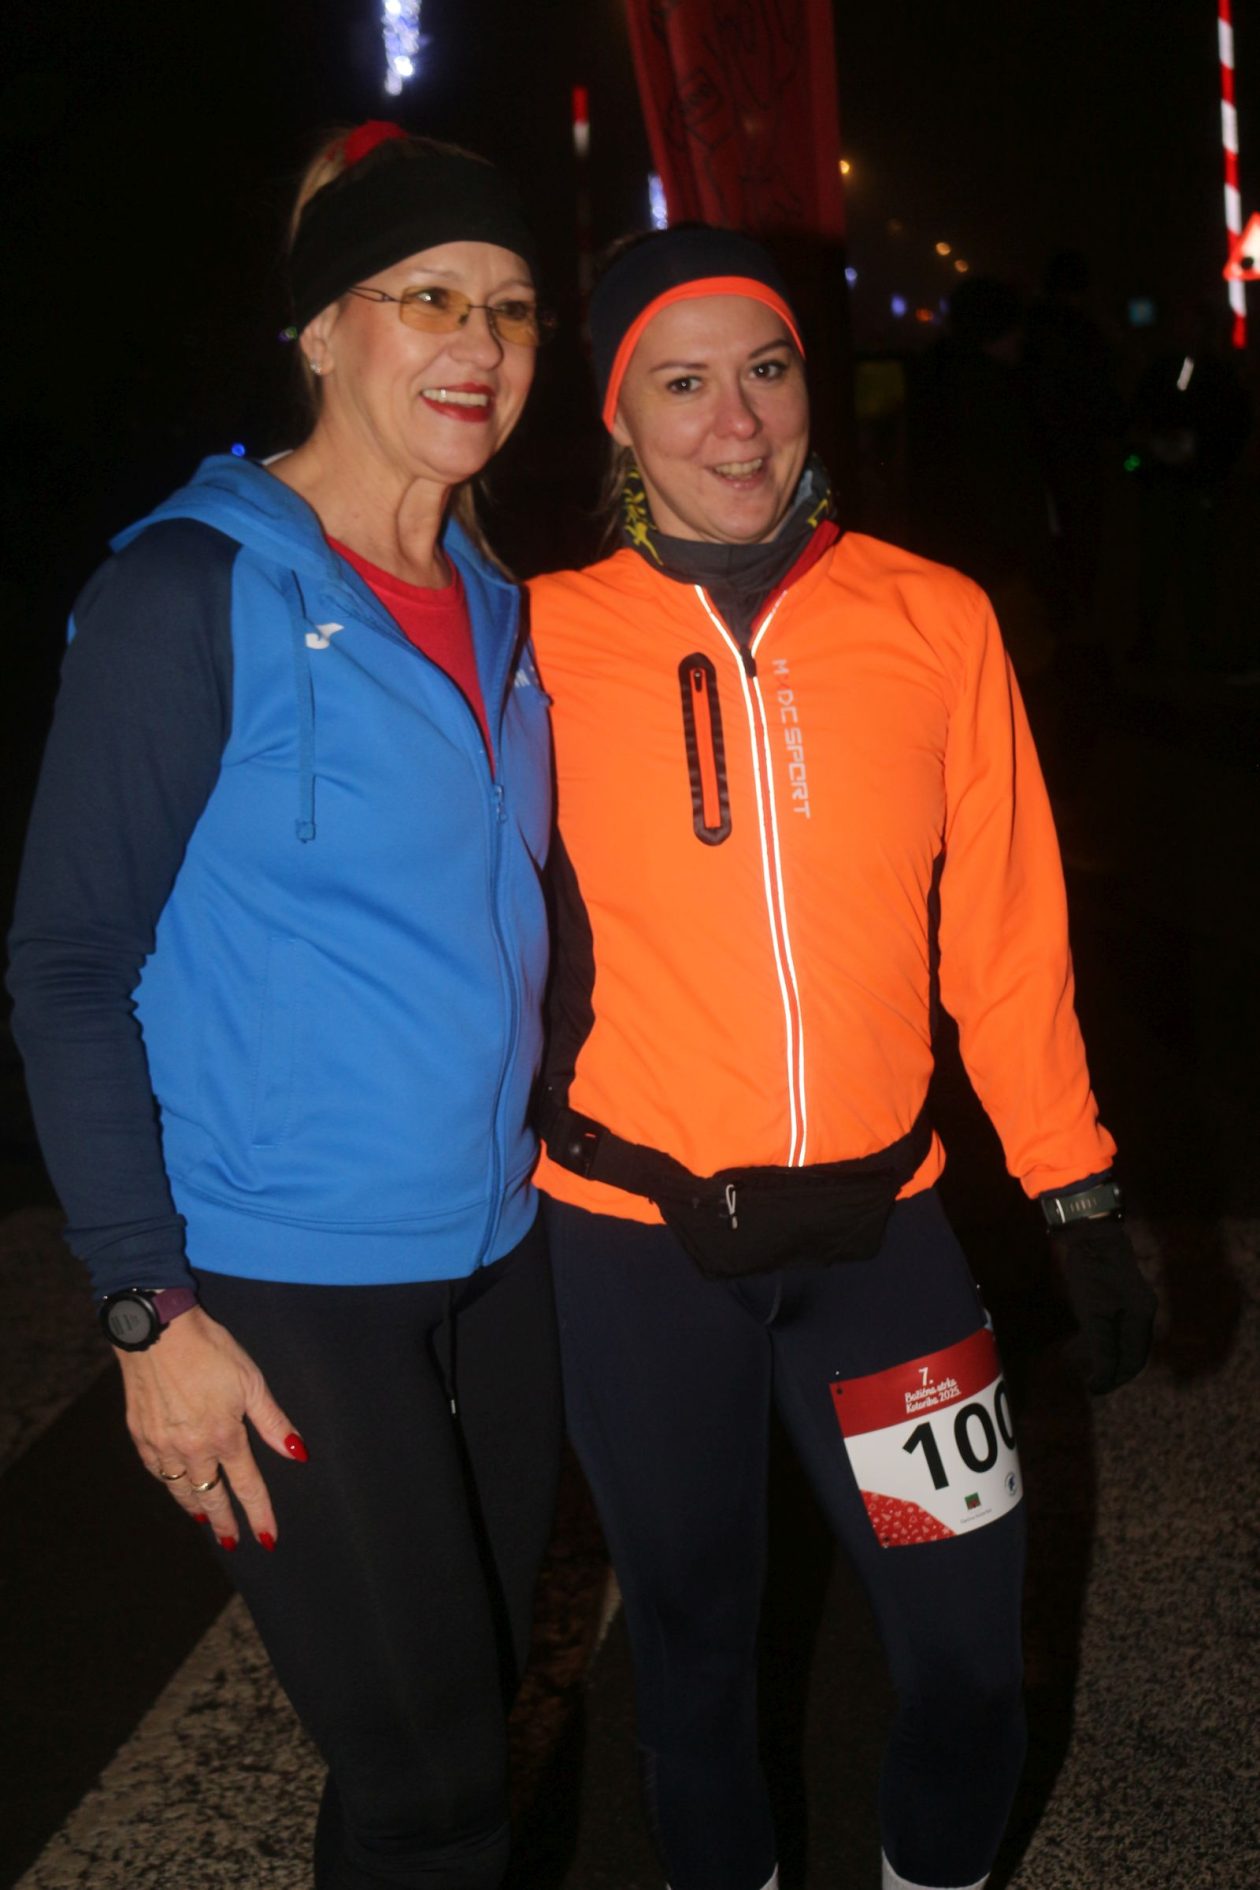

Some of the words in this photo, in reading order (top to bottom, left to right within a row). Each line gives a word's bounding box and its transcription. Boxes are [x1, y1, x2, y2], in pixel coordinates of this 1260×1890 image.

[772, 658, 798, 724] MDC
[784, 727, 811, 820] SPORT
[918, 1366, 934, 1386] 7.
